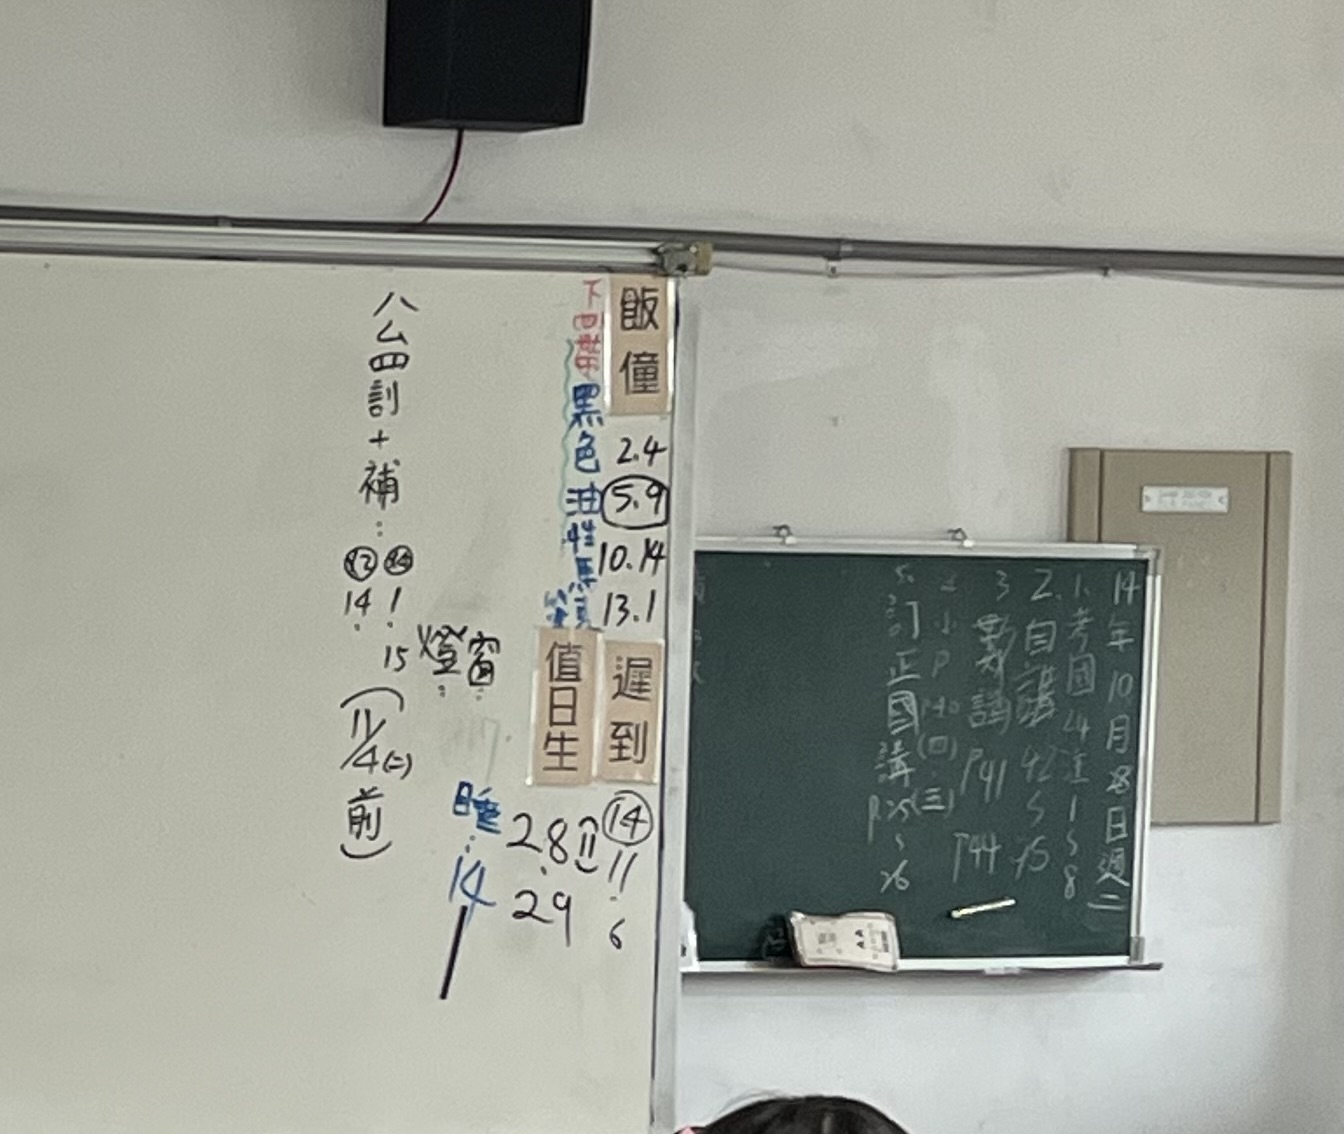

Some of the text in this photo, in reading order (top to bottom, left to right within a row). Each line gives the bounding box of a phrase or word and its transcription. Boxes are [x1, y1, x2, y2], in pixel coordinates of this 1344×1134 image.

[543, 641, 583, 772] 值日生
[610, 655, 653, 765] 遲到
